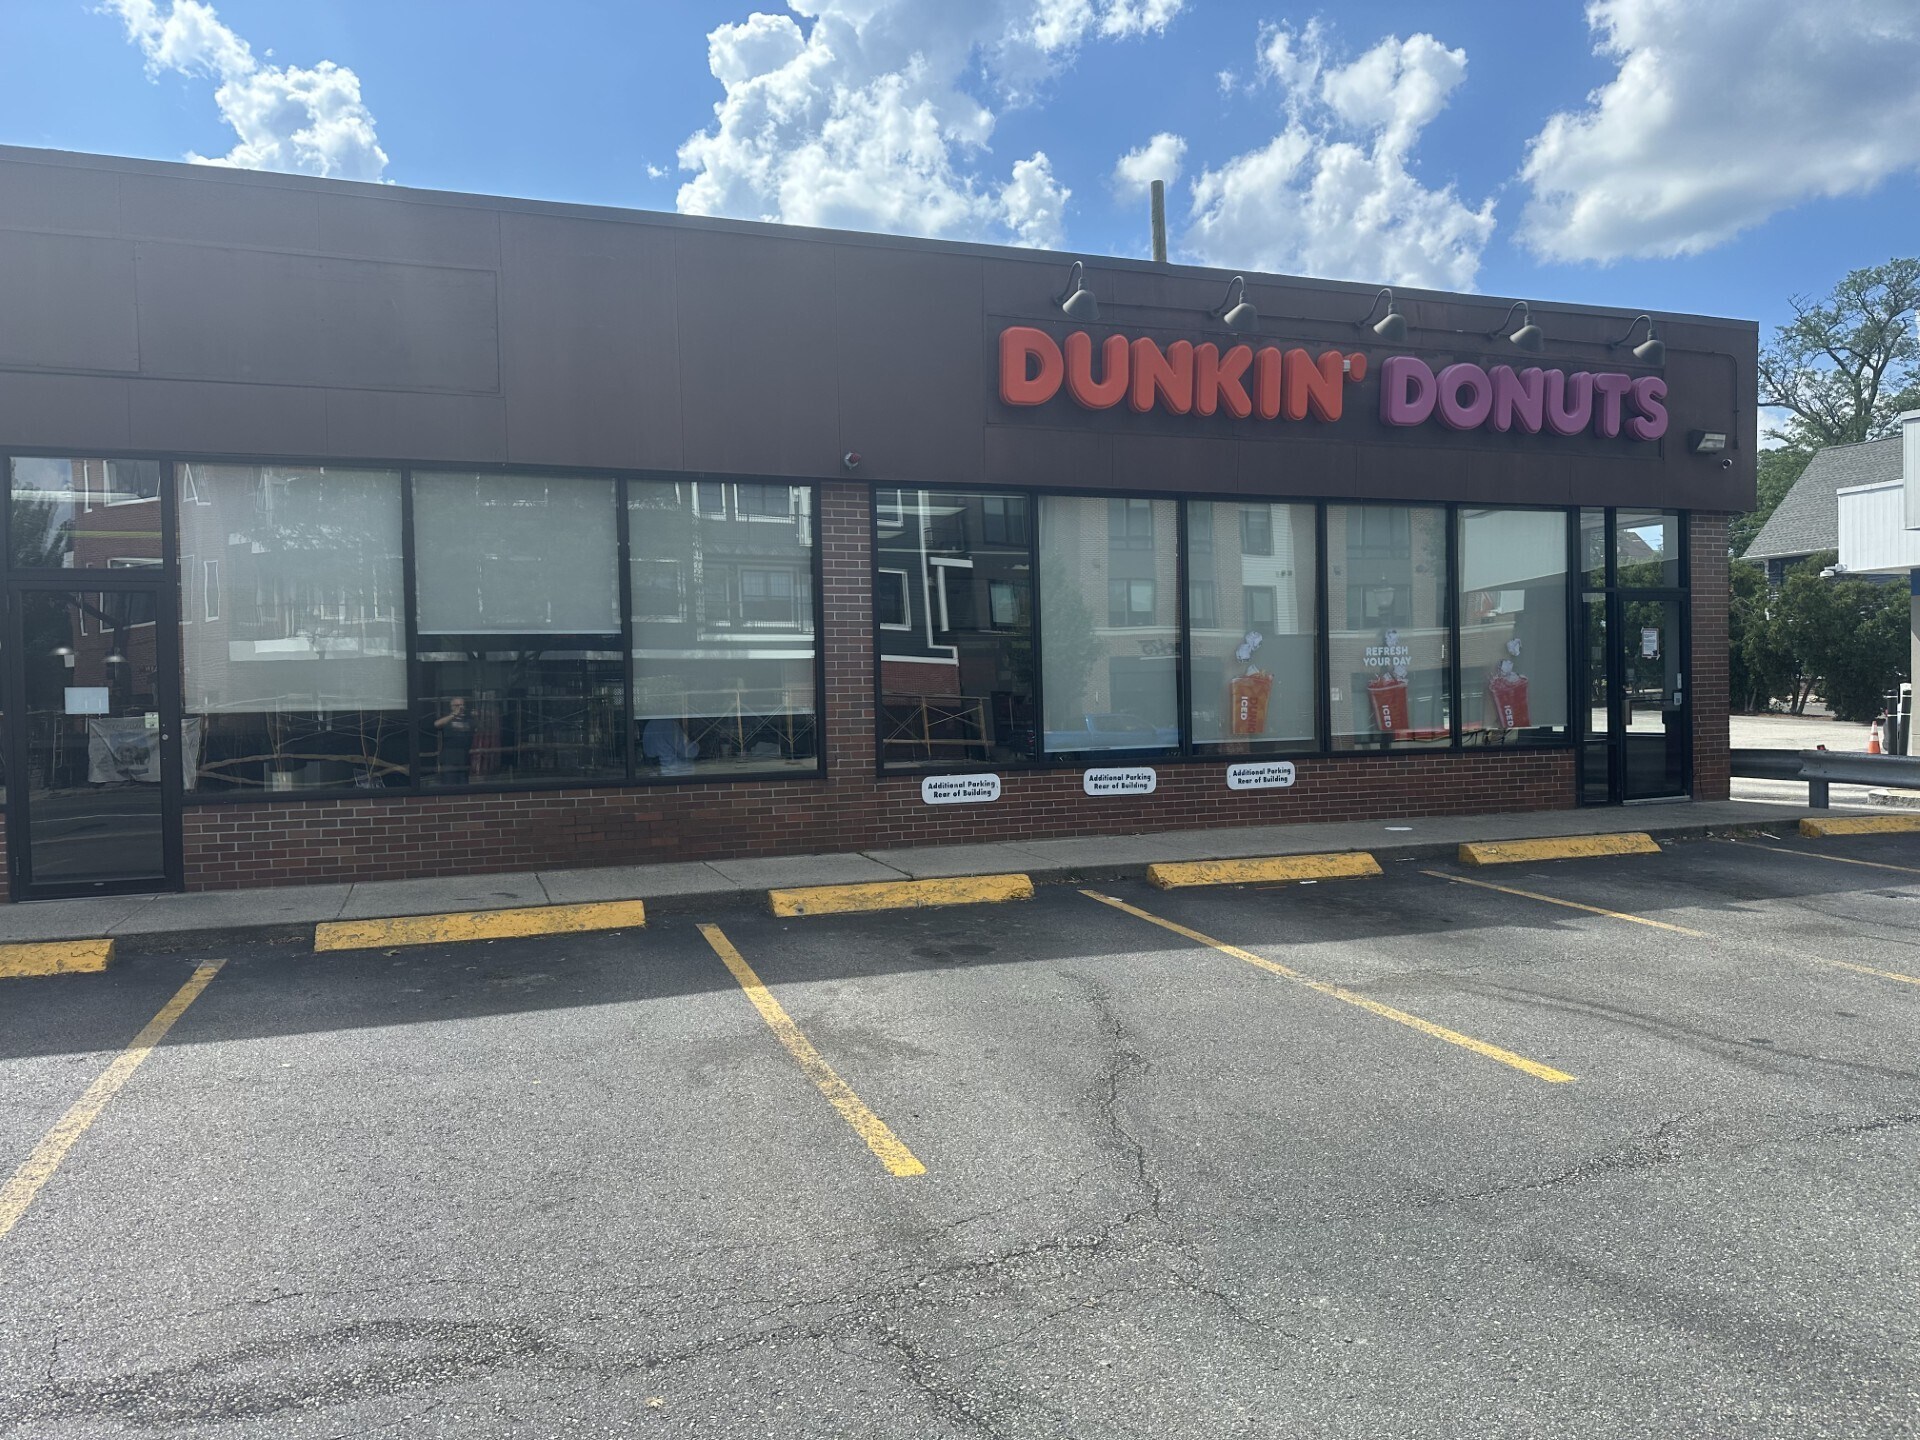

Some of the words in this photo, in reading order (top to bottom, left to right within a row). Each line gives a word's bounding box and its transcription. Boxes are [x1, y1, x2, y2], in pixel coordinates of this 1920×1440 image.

[1000, 326, 1367, 422] DUNKIN'
[1380, 355, 1668, 442] DONUTS
[1366, 646, 1408, 656] REFRESH
[1363, 657, 1390, 666] YOUR
[1393, 656, 1411, 666] DAY
[1240, 696, 1248, 721] ICED
[1382, 704, 1392, 728] ICED
[1504, 705, 1514, 727] ICED
[1233, 768, 1265, 776] Additional
[1267, 767, 1291, 775] Parking
[1126, 773, 1151, 782] Parking
[1263, 775, 1288, 783] Building
[928, 781, 965, 789] Additional
[968, 780, 996, 788] Parking
[1121, 782, 1148, 790] Building
[963, 788, 991, 797] Building
